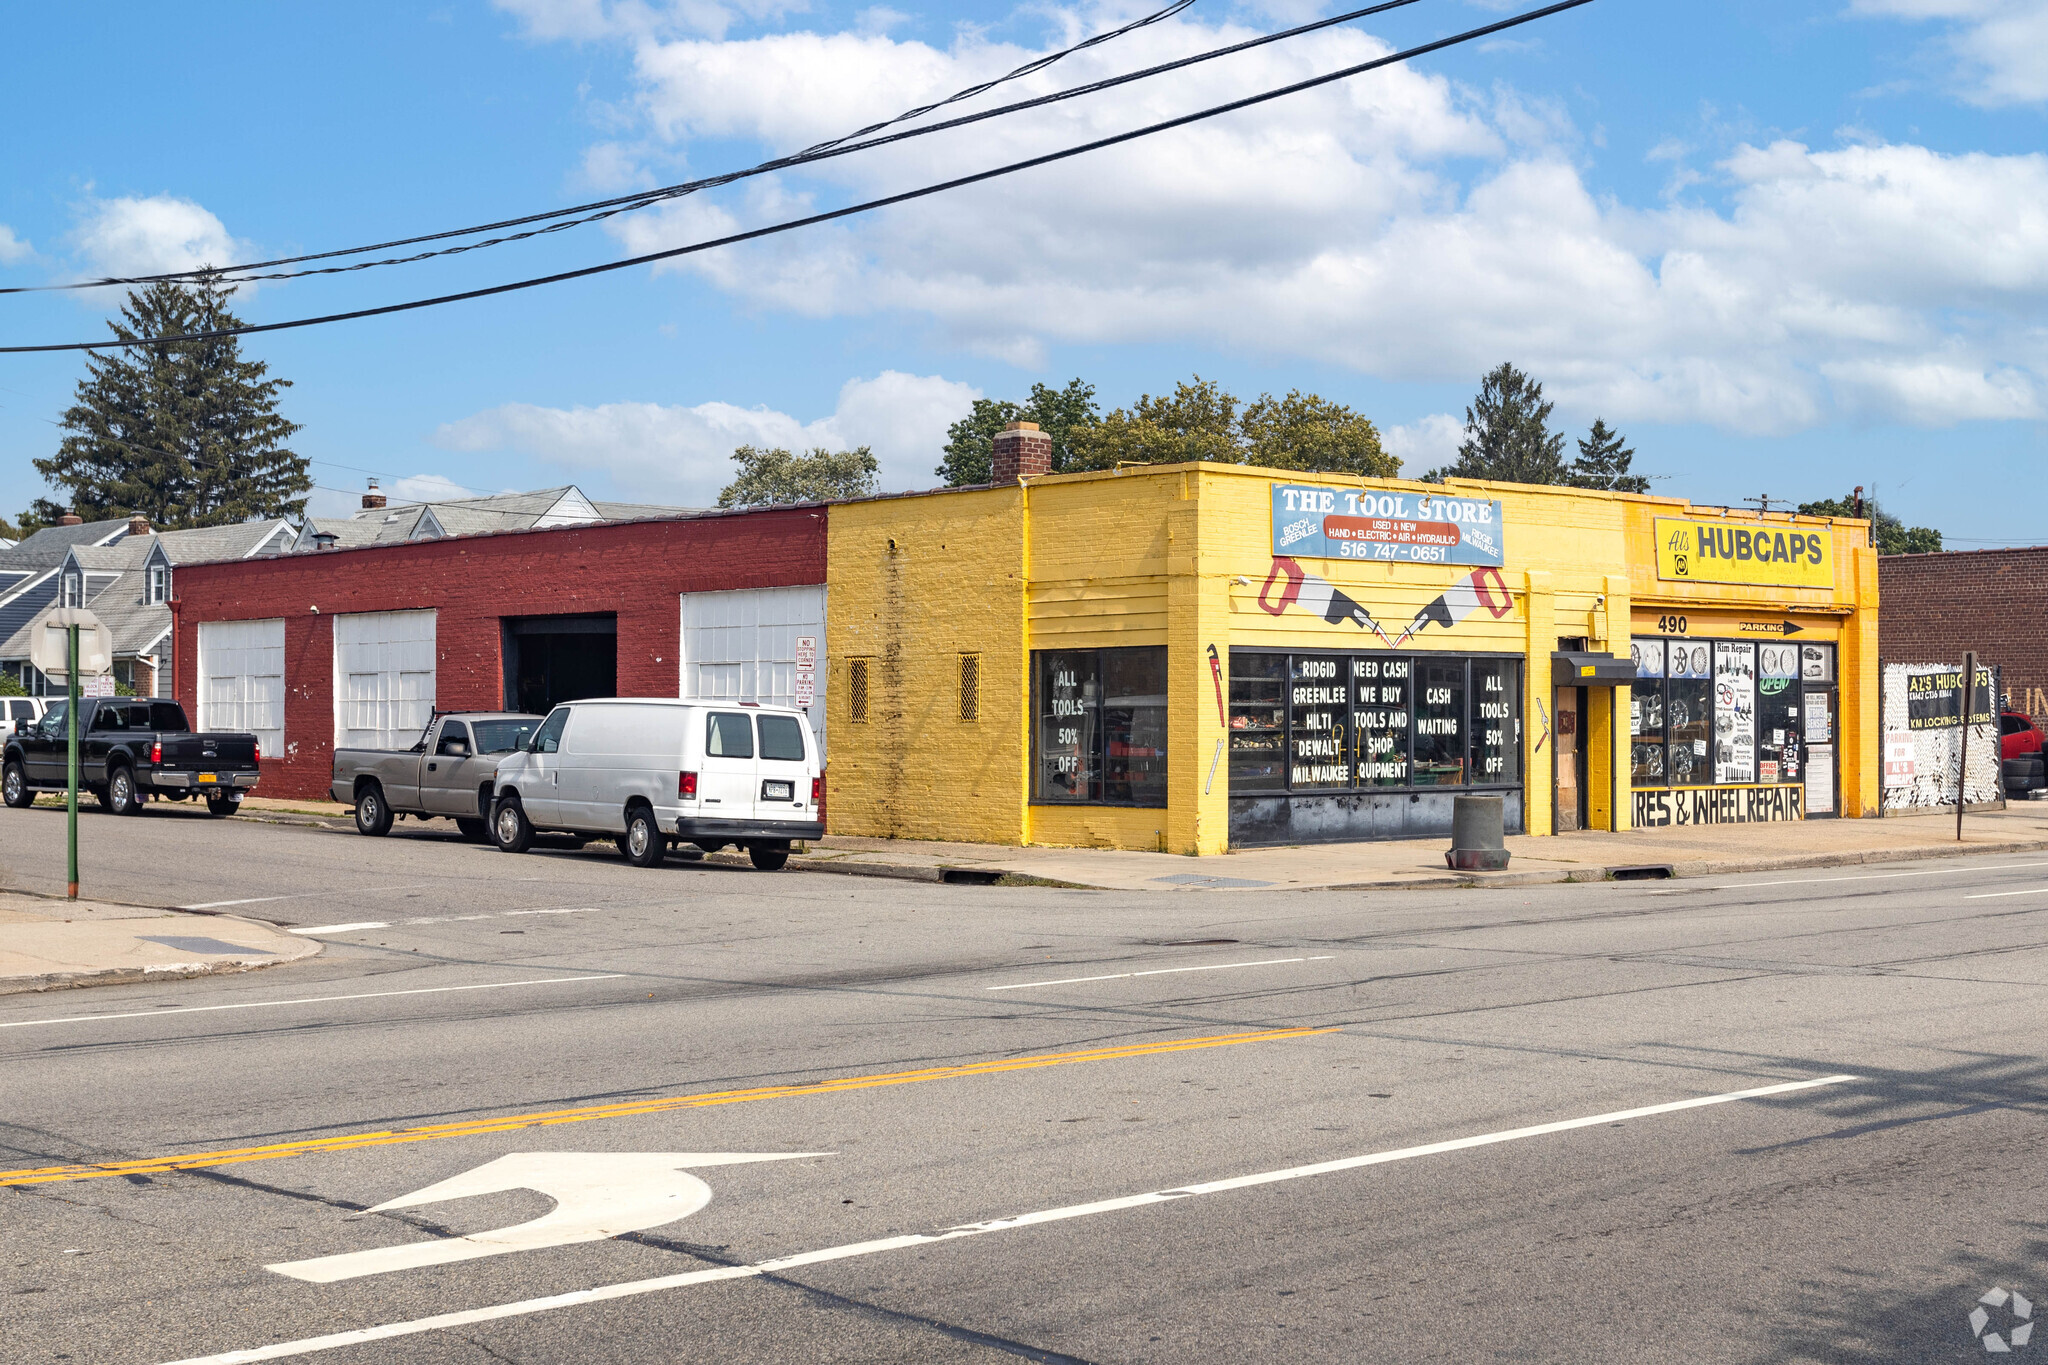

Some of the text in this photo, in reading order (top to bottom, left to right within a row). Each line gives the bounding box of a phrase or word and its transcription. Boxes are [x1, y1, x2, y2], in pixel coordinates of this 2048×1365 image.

[1282, 489, 1493, 524] THE TOOL STORE
[1283, 518, 1310, 536] BOSCH
[1373, 520, 1417, 532] USED & NEW
[1279, 523, 1318, 547] GREENLEE
[1329, 528, 1456, 545] HAND ELECTRIC AIR HYDRAULIC
[1471, 528, 1494, 546] RIDGID
[1668, 530, 1690, 552] Al's
[1340, 541, 1367, 557] 516
[1461, 531, 1500, 558] MILWAUKEE
[1697, 526, 1823, 565] HUBCAPS
[1658, 615, 1687, 633] 490
[1739, 622, 1784, 632] PARKING
[1717, 643, 1752, 656] Rim Repair
[1302, 661, 1336, 678] RIDGID
[1353, 661, 1408, 678] NEED CASH
[1058, 671, 1077, 687] ALL
[1485, 676, 1503, 691] ALL
[1761, 678, 1785, 690] OPEN
[1909, 672, 1988, 691] AL'S HUBCPS
[1293, 687, 1346, 704] GREENLEE
[1360, 686, 1401, 703] WE BUY
[1426, 688, 1451, 704] CASH
[1052, 699, 1084, 715] TOOLS
[1480, 702, 1509, 718] TOOLS
[1306, 713, 1332, 730] HILTI
[1354, 712, 1408, 728] TOOLS AND
[1418, 719, 1457, 735] WAITING
[1911, 713, 1990, 728] KM LOCKING SSTEMS
[1058, 728, 1078, 745] 50%
[1485, 730, 1503, 746] 50%
[1886, 733, 1913, 743] PARKING
[1299, 739, 1340, 756] DEWALT
[1368, 737, 1393, 754] SHOP
[1894, 748, 1905, 757] FOR
[1058, 756, 1078, 772] OFF
[1485, 757, 1503, 773] OFF
[1892, 761, 1908, 773] AL'S
[1292, 765, 1349, 784] MILWAUKEE
[1676, 791, 1690, 825] &
[1693, 789, 1746, 825] WHEEL
[1747, 787, 1801, 823] REPAIR
